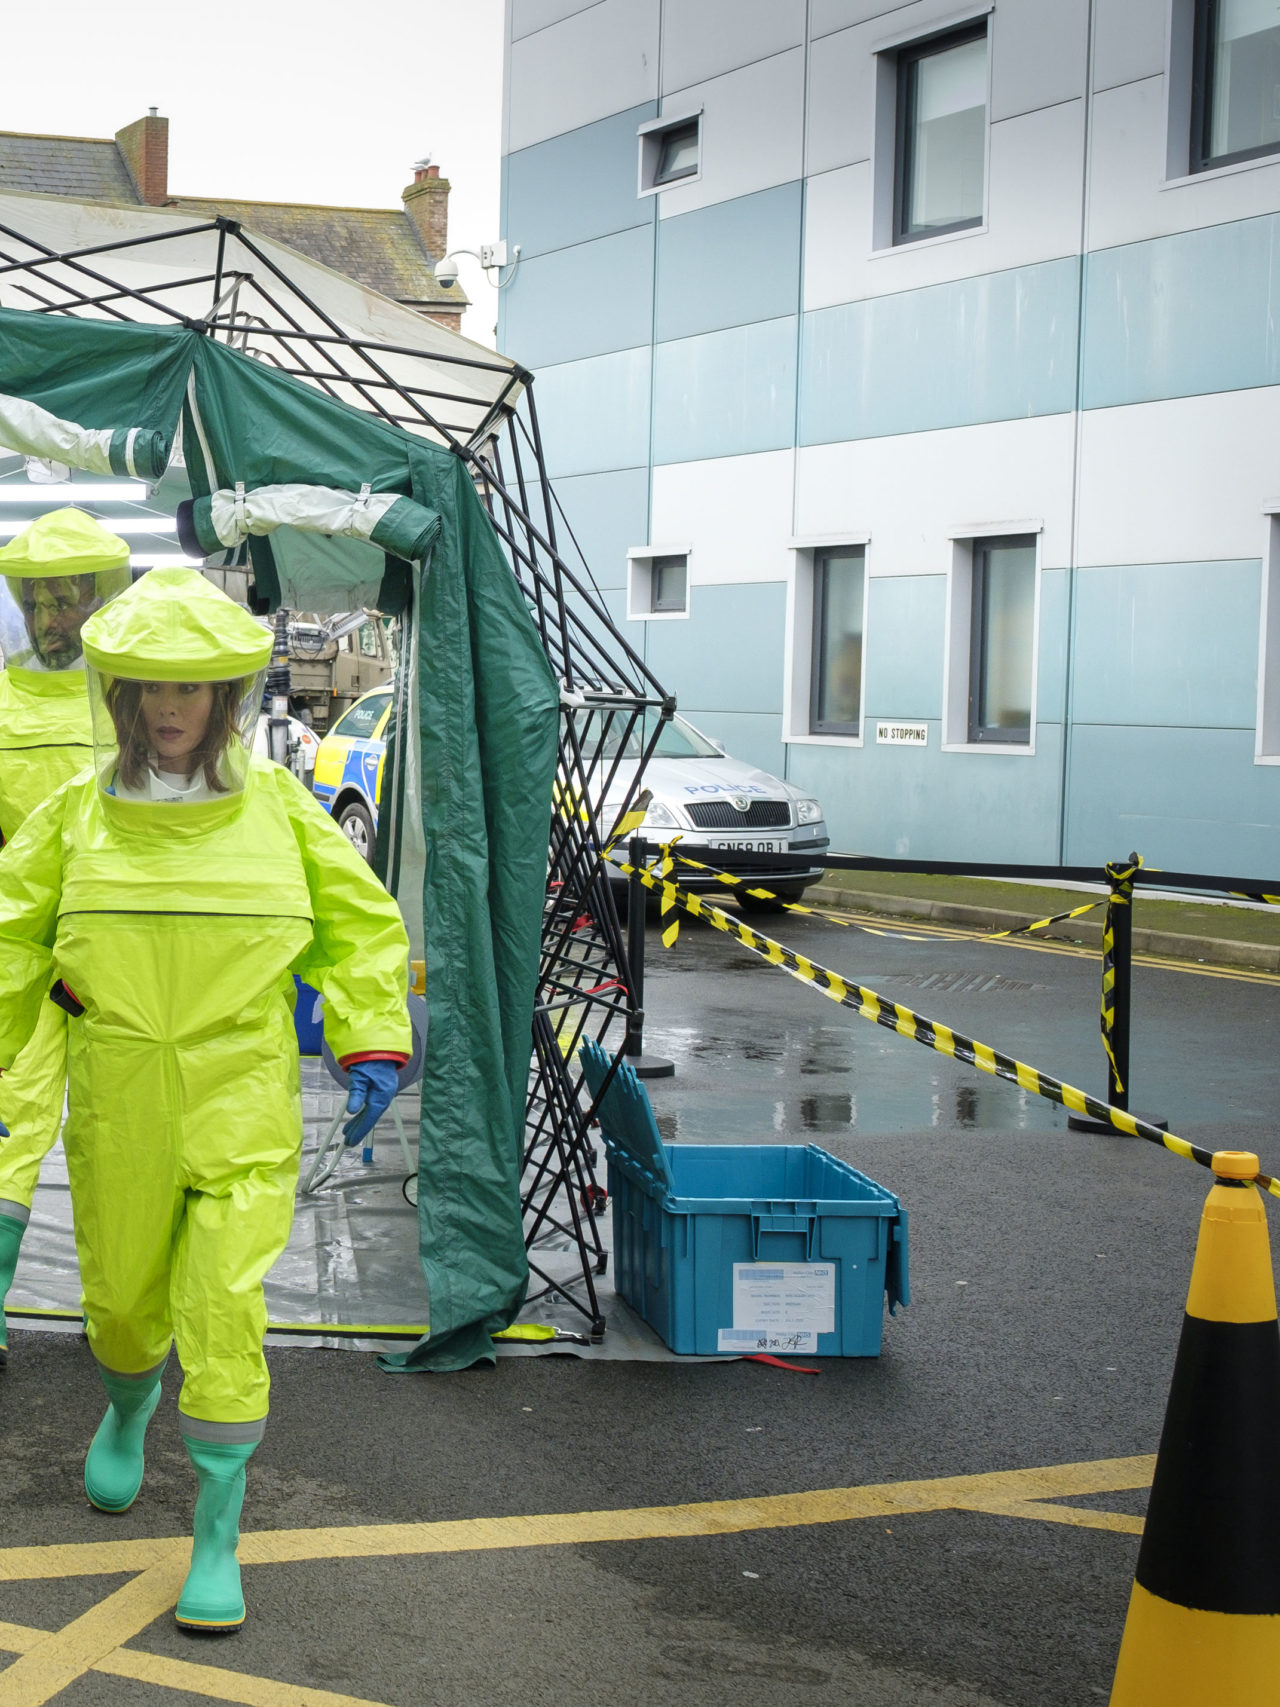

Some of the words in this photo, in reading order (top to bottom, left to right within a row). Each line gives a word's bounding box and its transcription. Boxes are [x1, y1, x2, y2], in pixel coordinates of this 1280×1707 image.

[354, 709, 374, 720] POLICE
[878, 727, 888, 738] NO
[891, 728, 926, 740] STOPPING
[684, 784, 767, 795] POLICE
